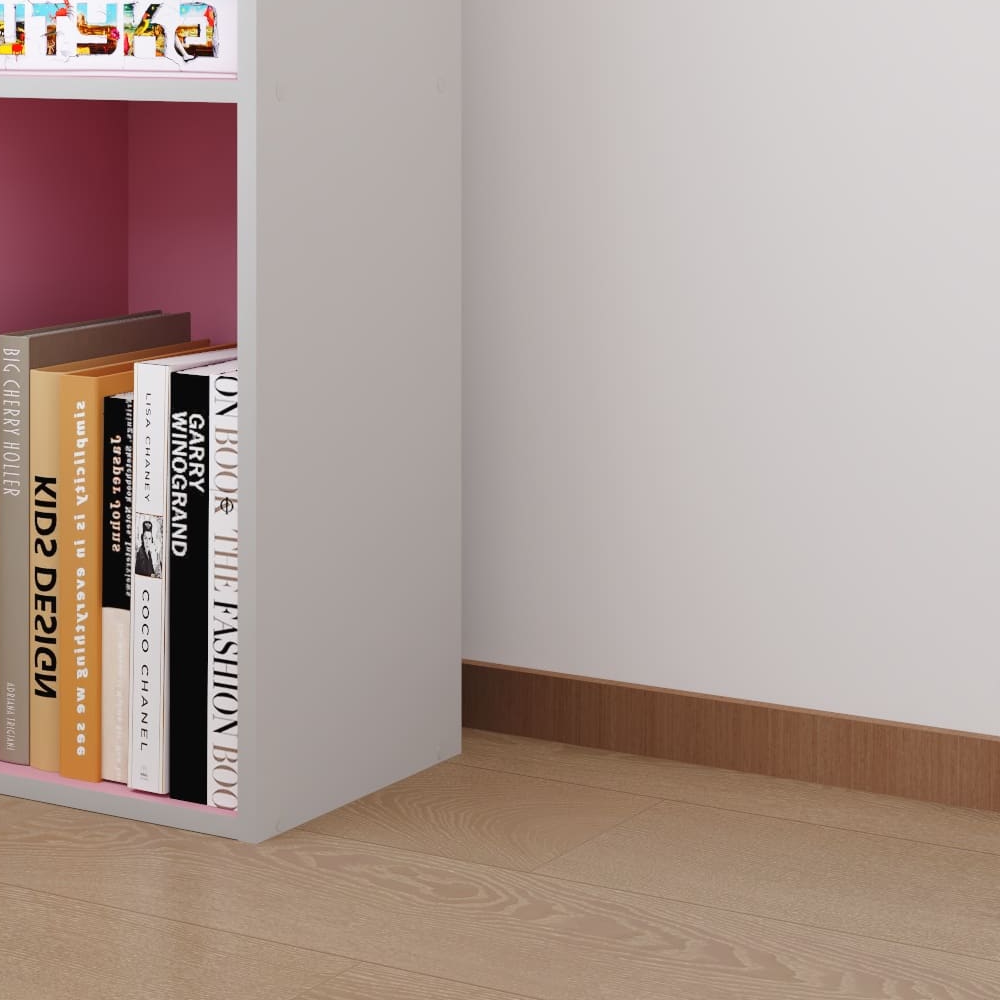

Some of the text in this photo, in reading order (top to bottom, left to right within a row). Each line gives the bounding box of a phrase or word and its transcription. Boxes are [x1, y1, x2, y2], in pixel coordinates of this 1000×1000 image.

[3, 348, 21, 497] BIG CHERRY HOLLER
[172, 411, 188, 558] WINOGRAND
[188, 412, 205, 493] GARRY
[214, 529, 238, 593] THE
[6, 682, 16, 715] ADRIANA
[140, 589, 150, 751] COCO CHANEL
[212, 600, 238, 736] FASHION
